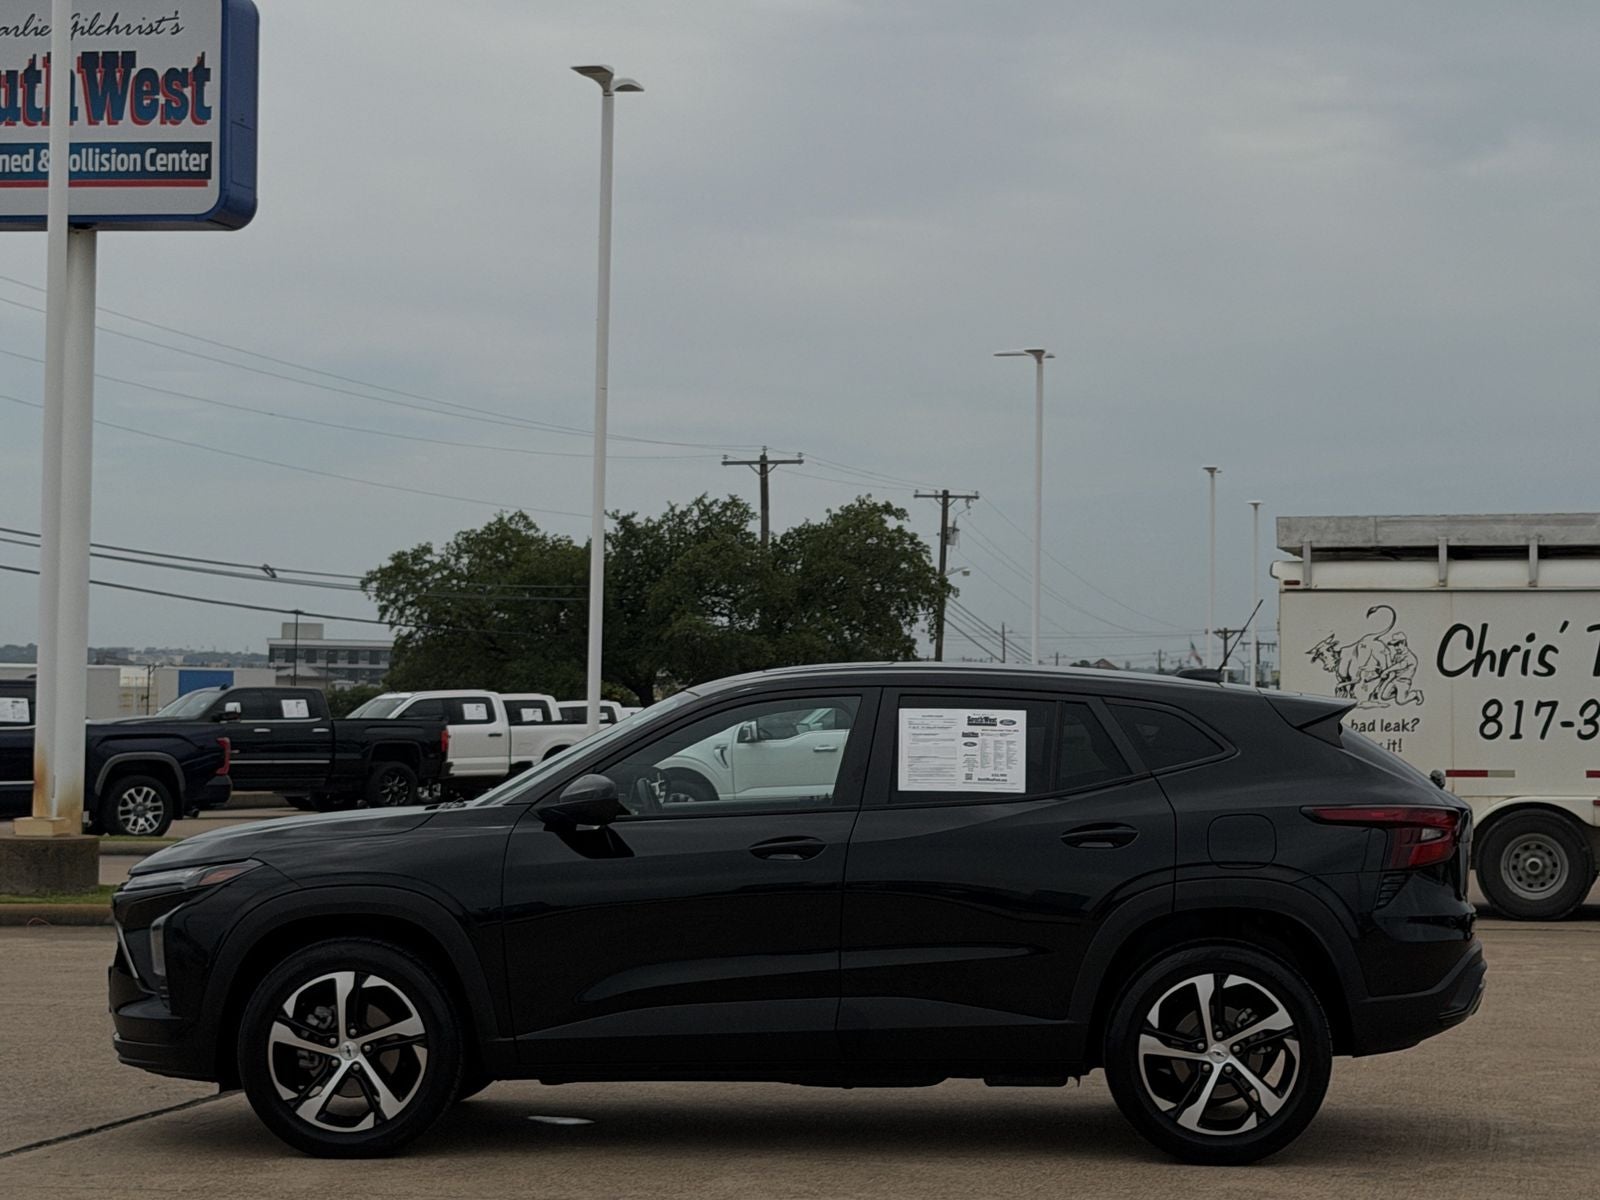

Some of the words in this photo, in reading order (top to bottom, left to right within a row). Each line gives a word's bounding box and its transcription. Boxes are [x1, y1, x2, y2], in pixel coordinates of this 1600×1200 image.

[69, 147, 141, 173] ollision
[145, 147, 209, 173] Center
[1436, 620, 1570, 678] Chris'
[1380, 717, 1421, 733] leak?
[1478, 698, 1600, 740] 817-3
[1386, 738, 1403, 753] it!
